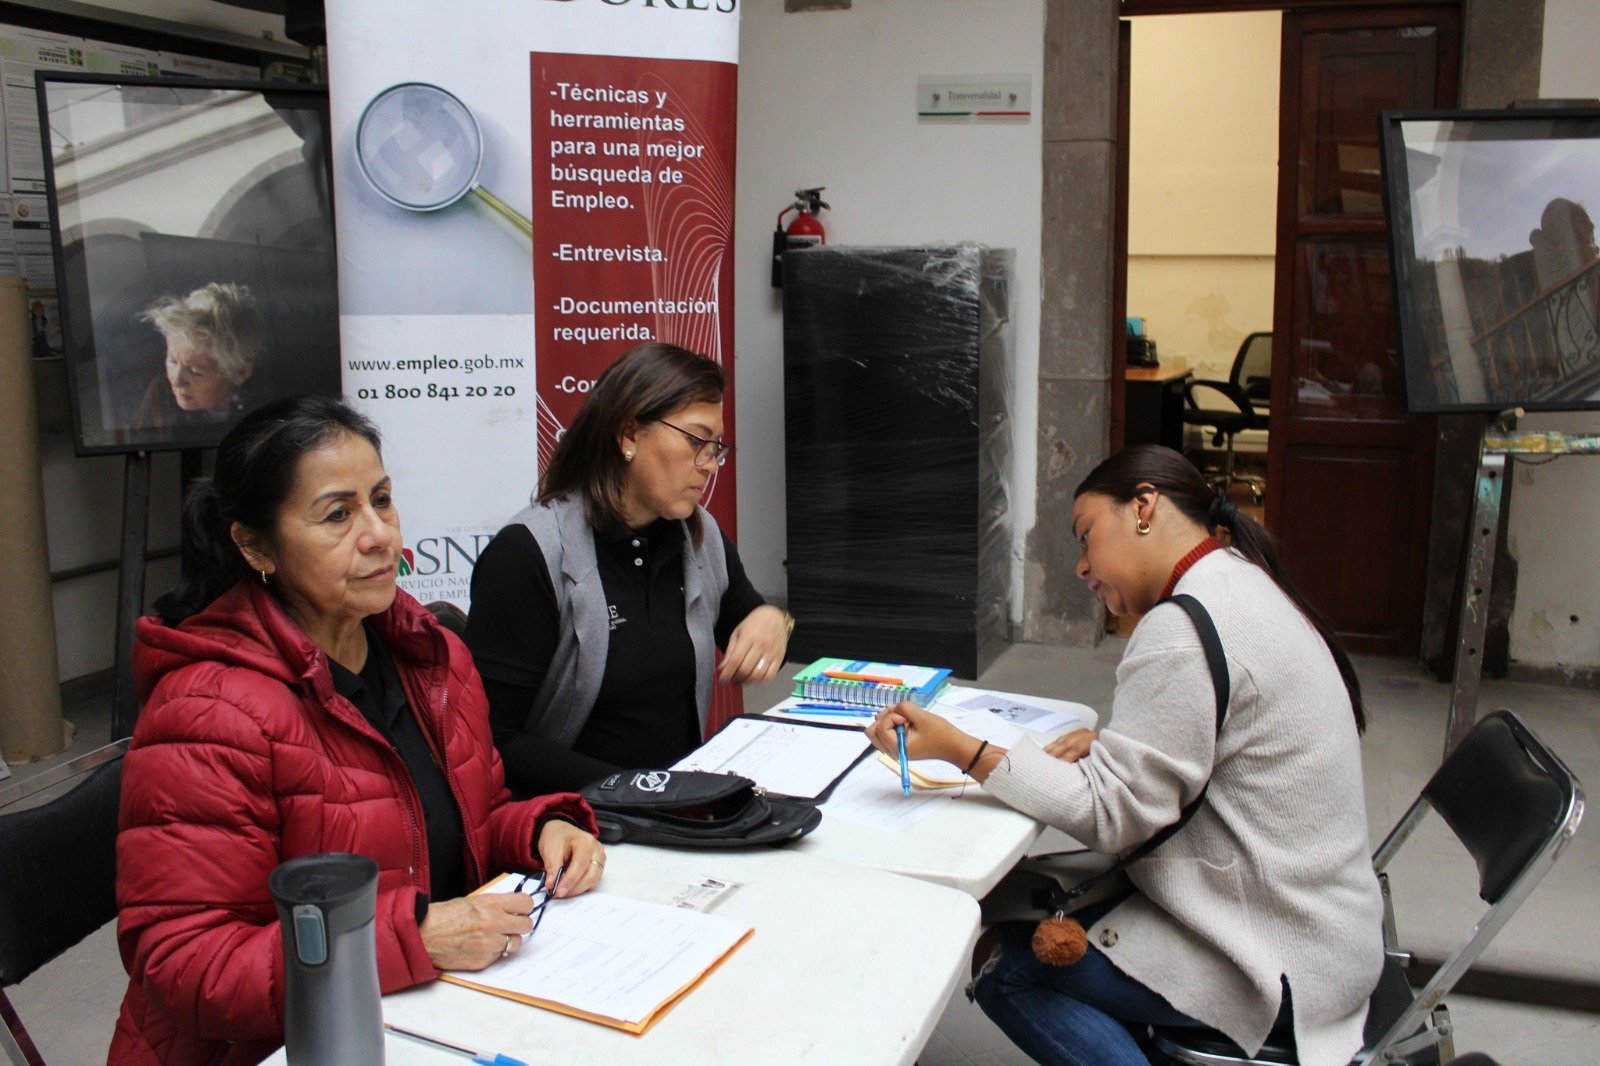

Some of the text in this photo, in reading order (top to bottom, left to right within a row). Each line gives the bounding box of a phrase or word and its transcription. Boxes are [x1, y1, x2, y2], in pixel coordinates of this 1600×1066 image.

[550, 83, 667, 109] -Técnicas y
[551, 109, 685, 131] herramientas
[551, 141, 705, 161] para una mejor
[551, 163, 683, 186] búsqueda de
[551, 190, 634, 212] Empleo.
[552, 244, 668, 262] -Entrevista.
[553, 297, 718, 314] -Documentación
[553, 323, 656, 345] requerida.
[348, 354, 524, 374] www.empleo.gob.mx
[357, 383, 516, 401] 01 800 841 20 20
[416, 534, 496, 575] SN
[401, 578, 444, 590] RVICIO
[420, 589, 471, 601] DE EMPL
